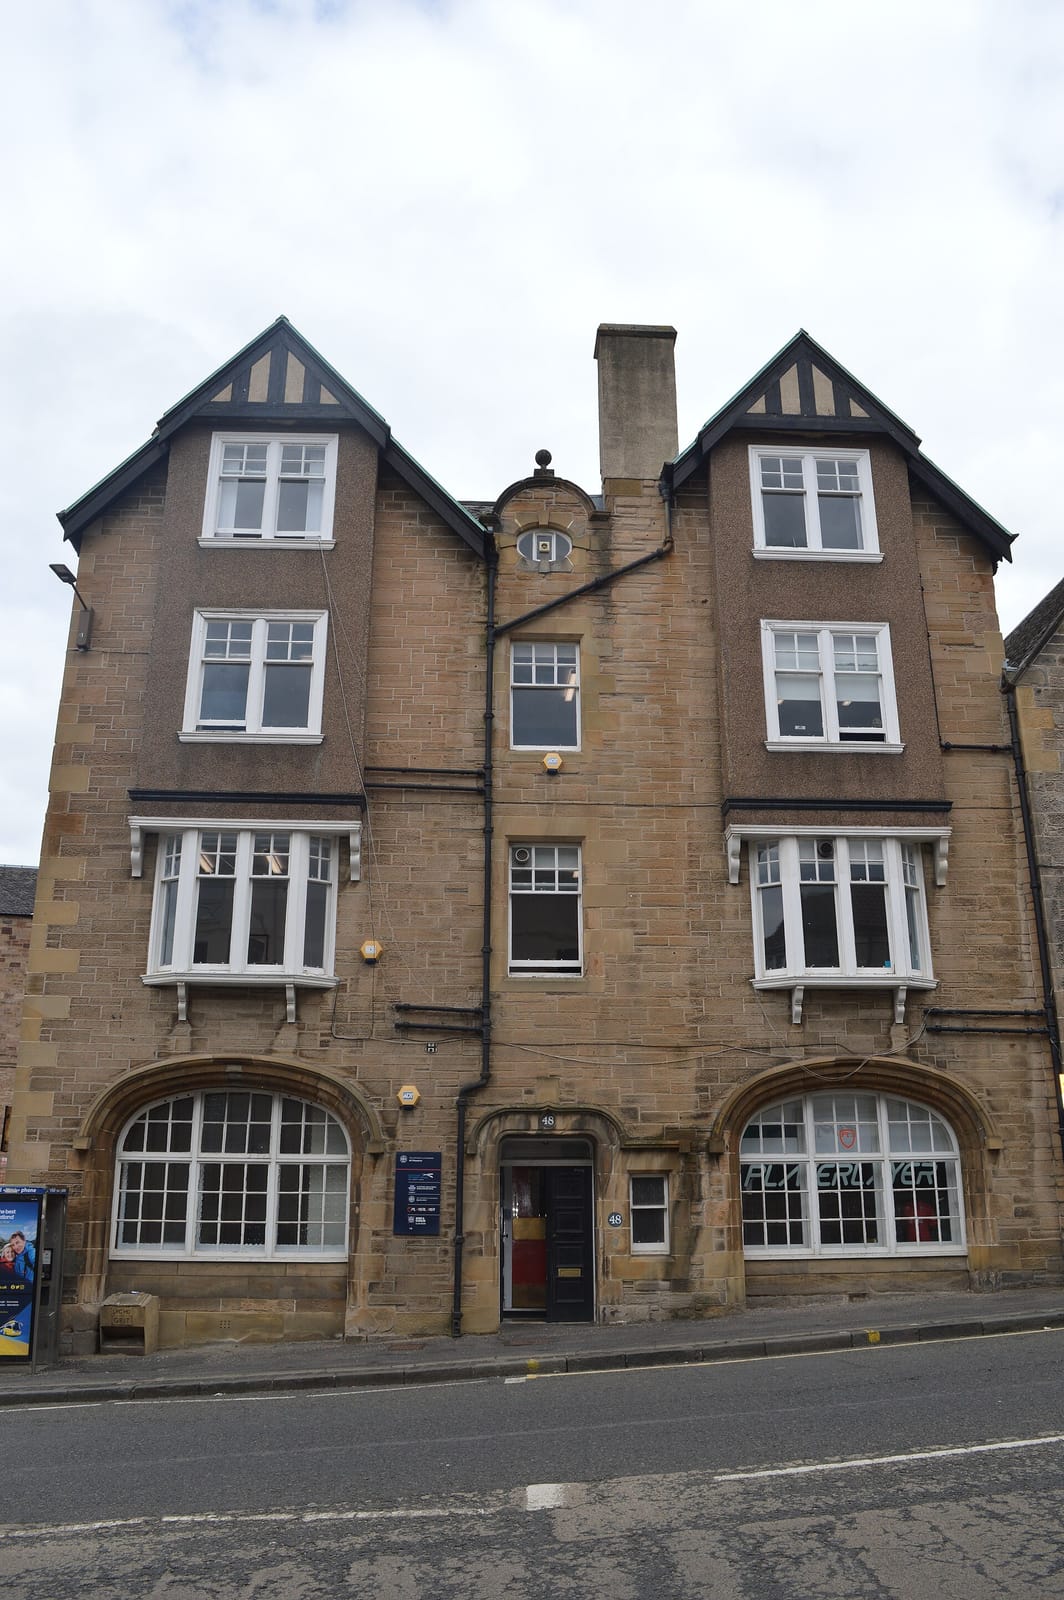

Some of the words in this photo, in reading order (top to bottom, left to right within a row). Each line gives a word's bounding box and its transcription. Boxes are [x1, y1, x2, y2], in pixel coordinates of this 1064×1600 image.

[541, 1115, 555, 1126] 48
[743, 1162, 938, 1187] PLAERLYER
[608, 1214, 622, 1225] 48
